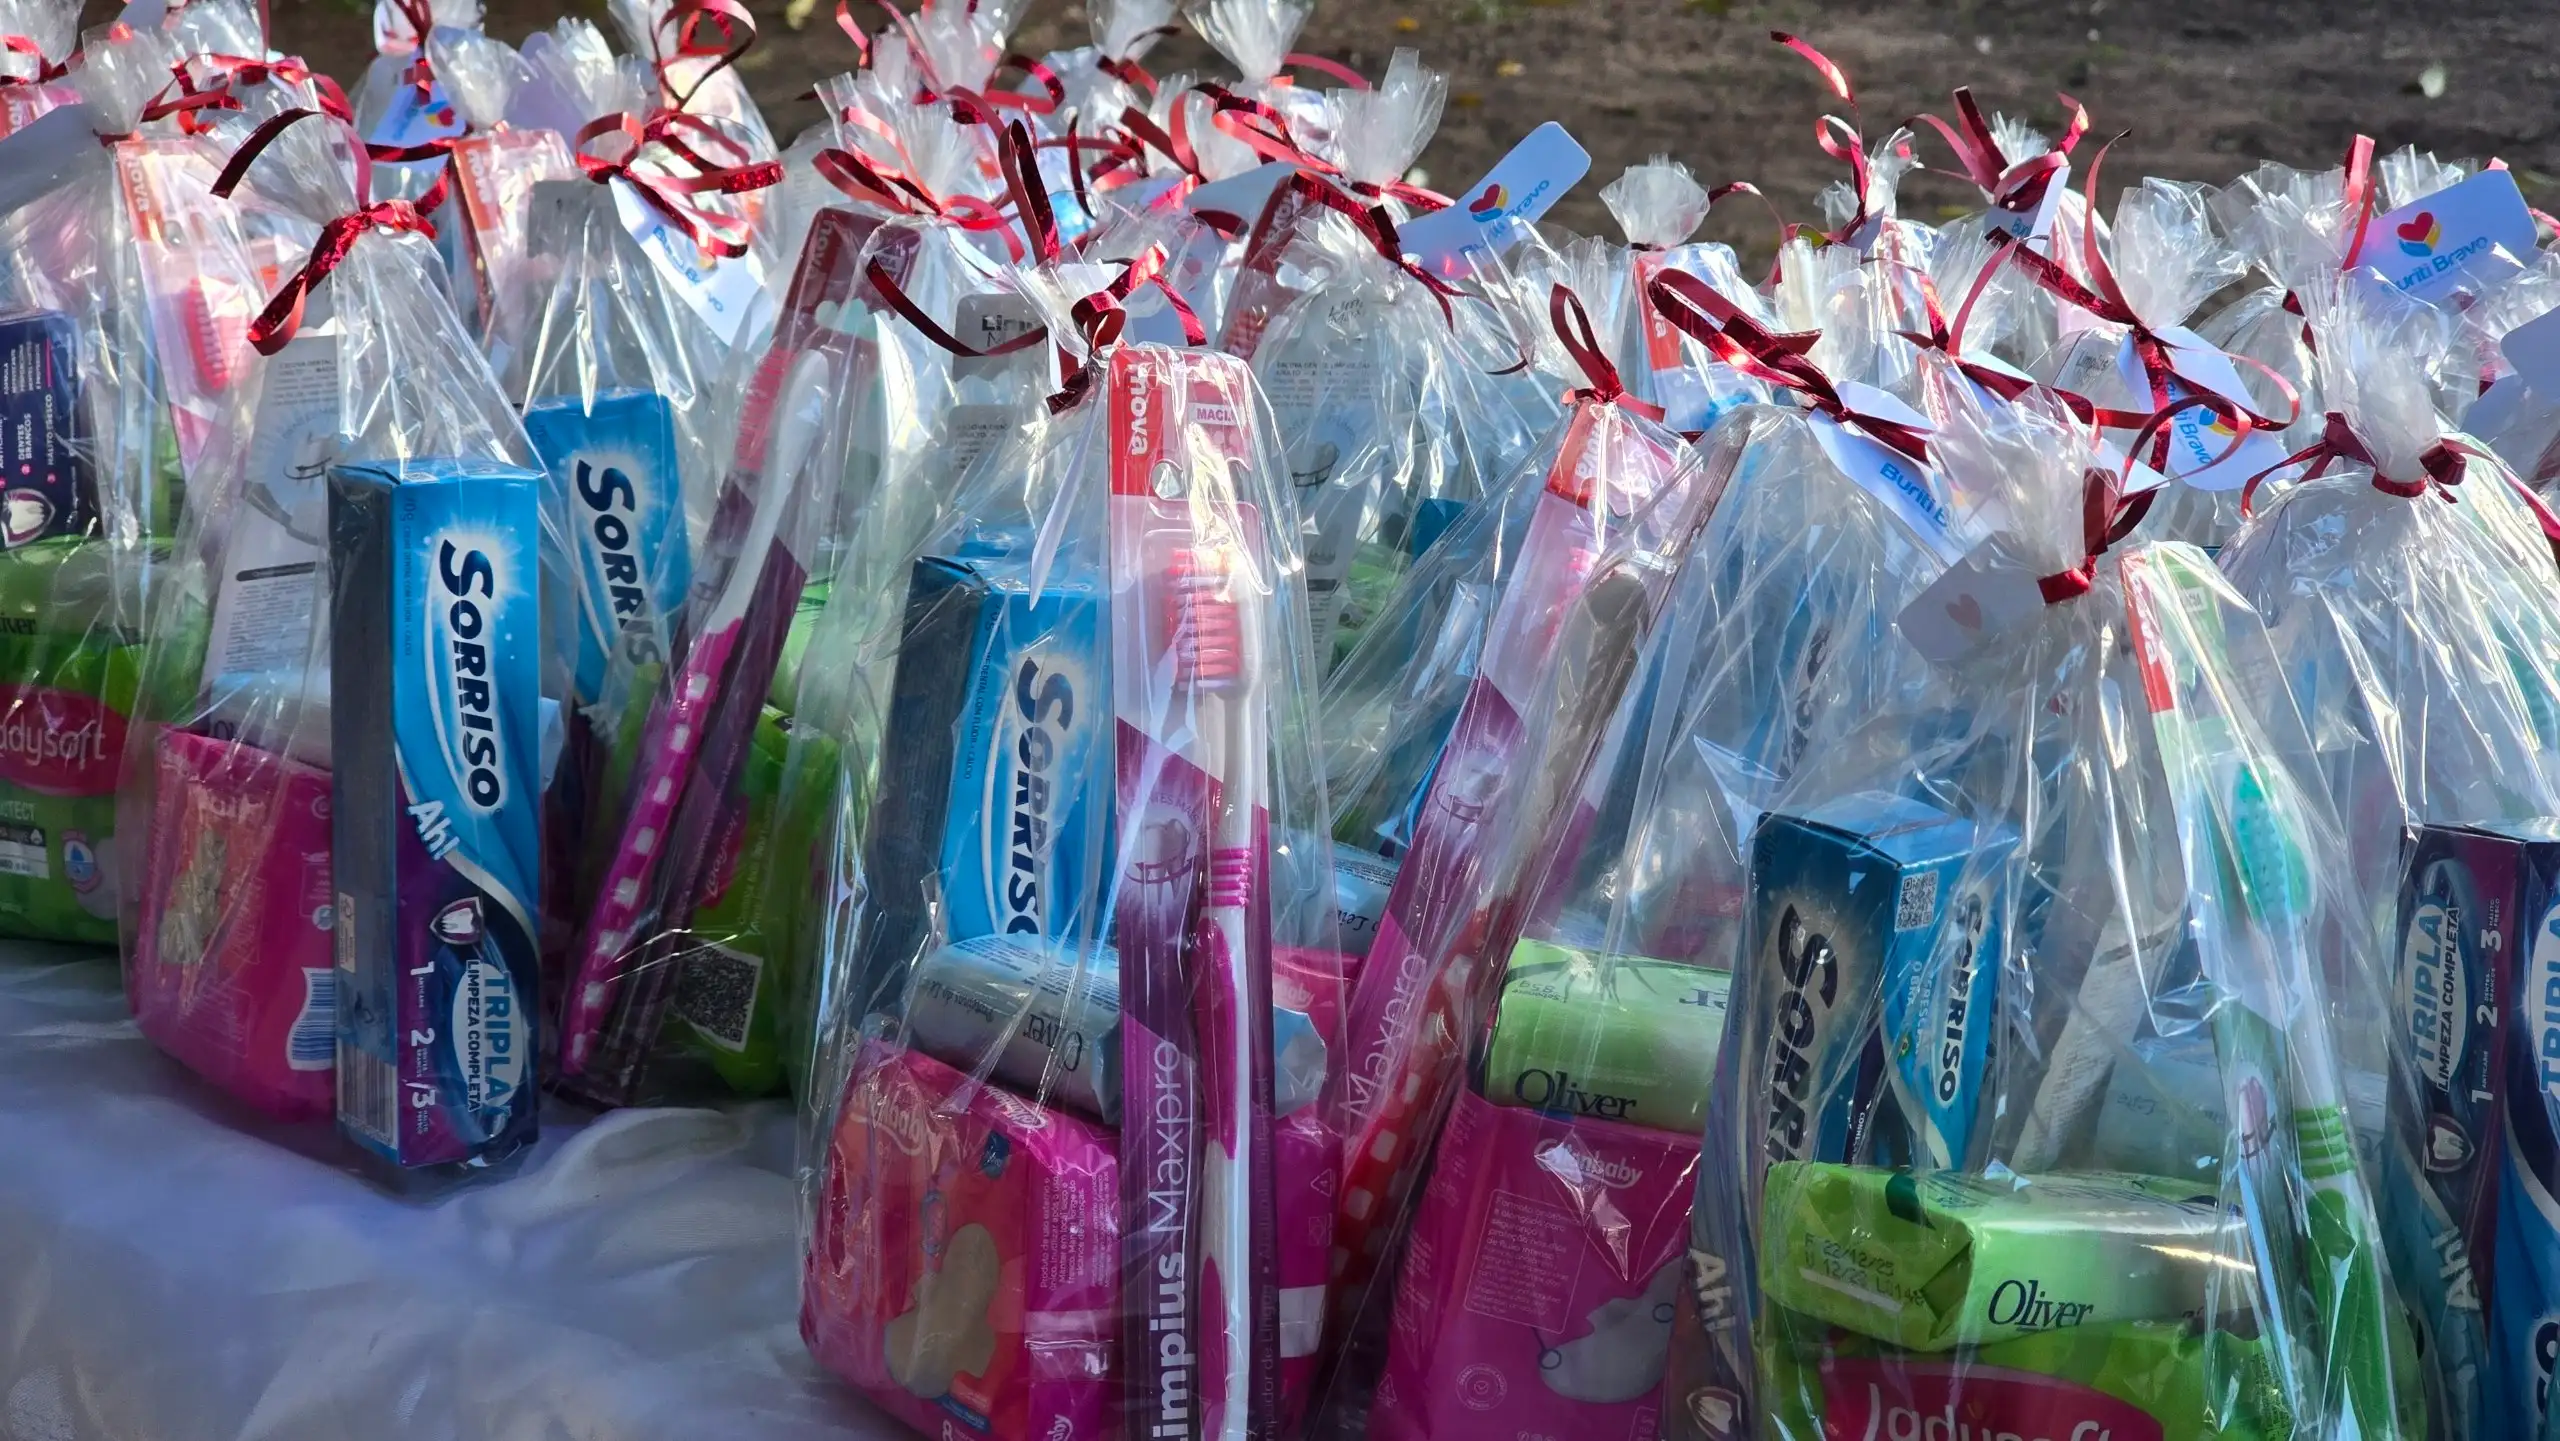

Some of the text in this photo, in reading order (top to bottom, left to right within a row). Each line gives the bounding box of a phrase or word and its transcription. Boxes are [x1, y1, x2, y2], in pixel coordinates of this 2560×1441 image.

[2432, 236, 2489, 273] Bravo
[24, 413, 33, 460] BRANCOS
[1196, 408, 1233, 422] MACI
[17, 424, 26, 460] DENTES
[2180, 423, 2213, 465] Bravo
[1880, 462, 1936, 513] Buriti
[575, 458, 662, 669] SORRIS
[437, 537, 502, 809] SORRISO
[980, 663, 992, 693] DENTAL
[976, 695, 986, 713] COM
[407, 799, 462, 860] Ah!
[2480, 928, 2503, 952] 3
[410, 960, 435, 976] 1
[2410, 913, 2444, 1065] TRIPLA
[2437, 907, 2461, 1094] LIMPEZA COMPLETA
[2476, 1004, 2498, 1028] 2
[411, 1027, 435, 1047] 2
[466, 959, 482, 1112] LIMPEZA COMPLETA
[484, 974, 511, 1101] TRIPLA
[1338, 953, 1428, 1120] Maxpro
[412, 1089, 436, 1109] 3
[1514, 1068, 1637, 1120] Oliver
[2471, 1089, 2493, 1103] 1
[1149, 1041, 1196, 1441] impius Maxpro
[1040, 1251, 1050, 1289] Produto
[1690, 1247, 1737, 1332] Ah!
[2431, 1225, 2483, 1311] Ah!
[1987, 1279, 2094, 1329] Oliver
